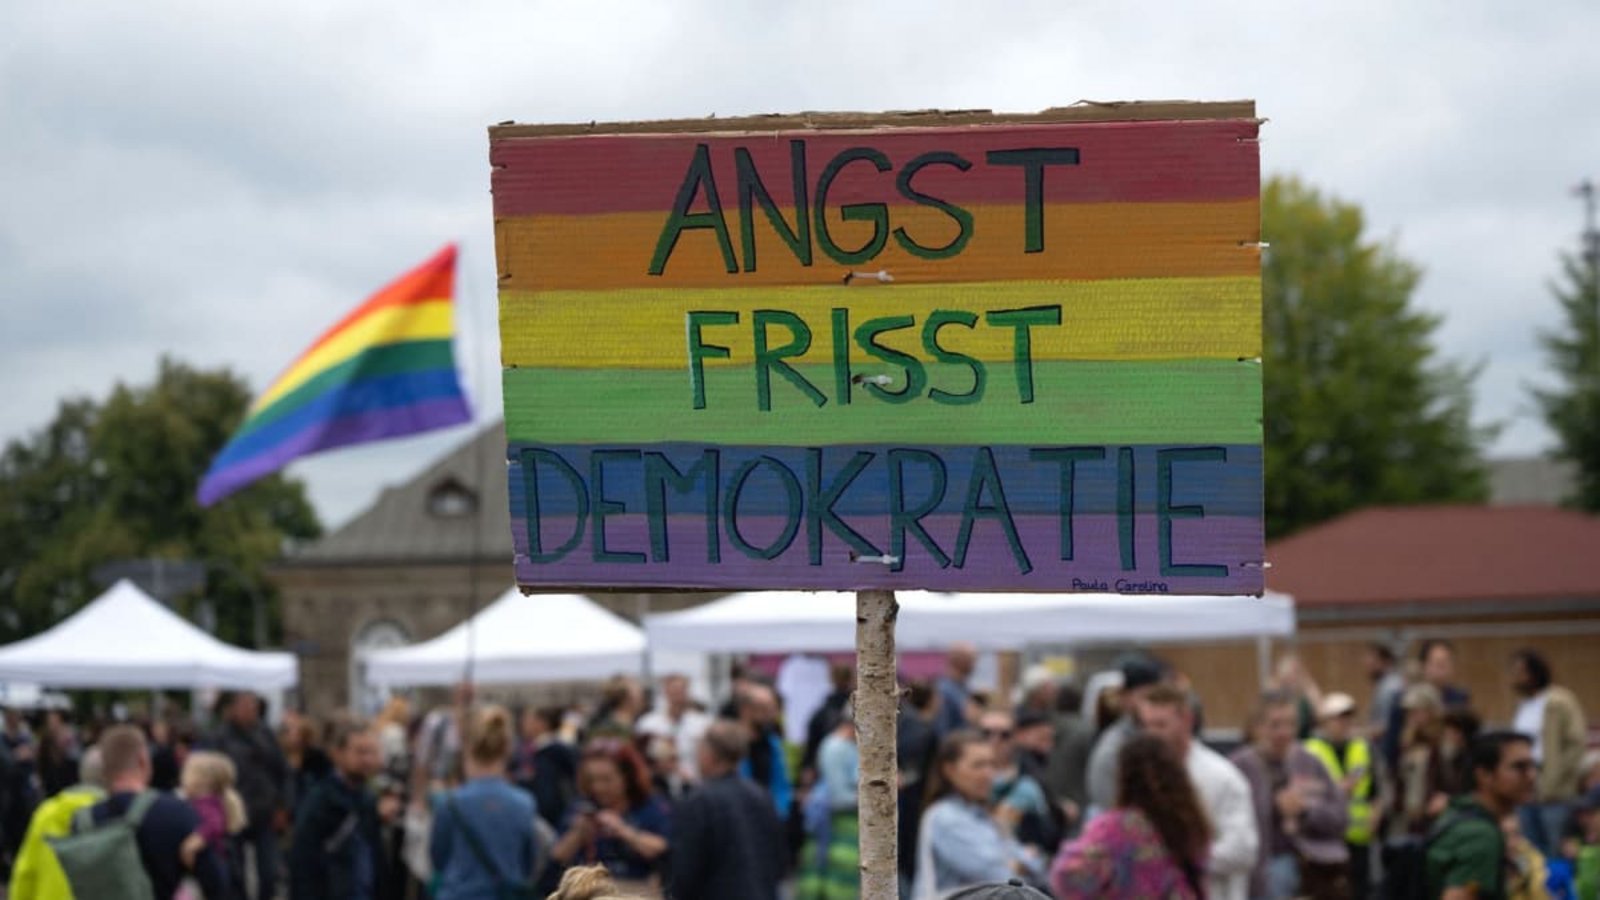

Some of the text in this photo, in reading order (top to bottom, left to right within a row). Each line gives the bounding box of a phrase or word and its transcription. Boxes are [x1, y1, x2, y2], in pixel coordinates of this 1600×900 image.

[647, 140, 1080, 276] ANGST
[686, 304, 1062, 411] FRISST
[519, 446, 1229, 577] DEMOKRATIE
[1072, 578, 1169, 593] Paula Carolina
